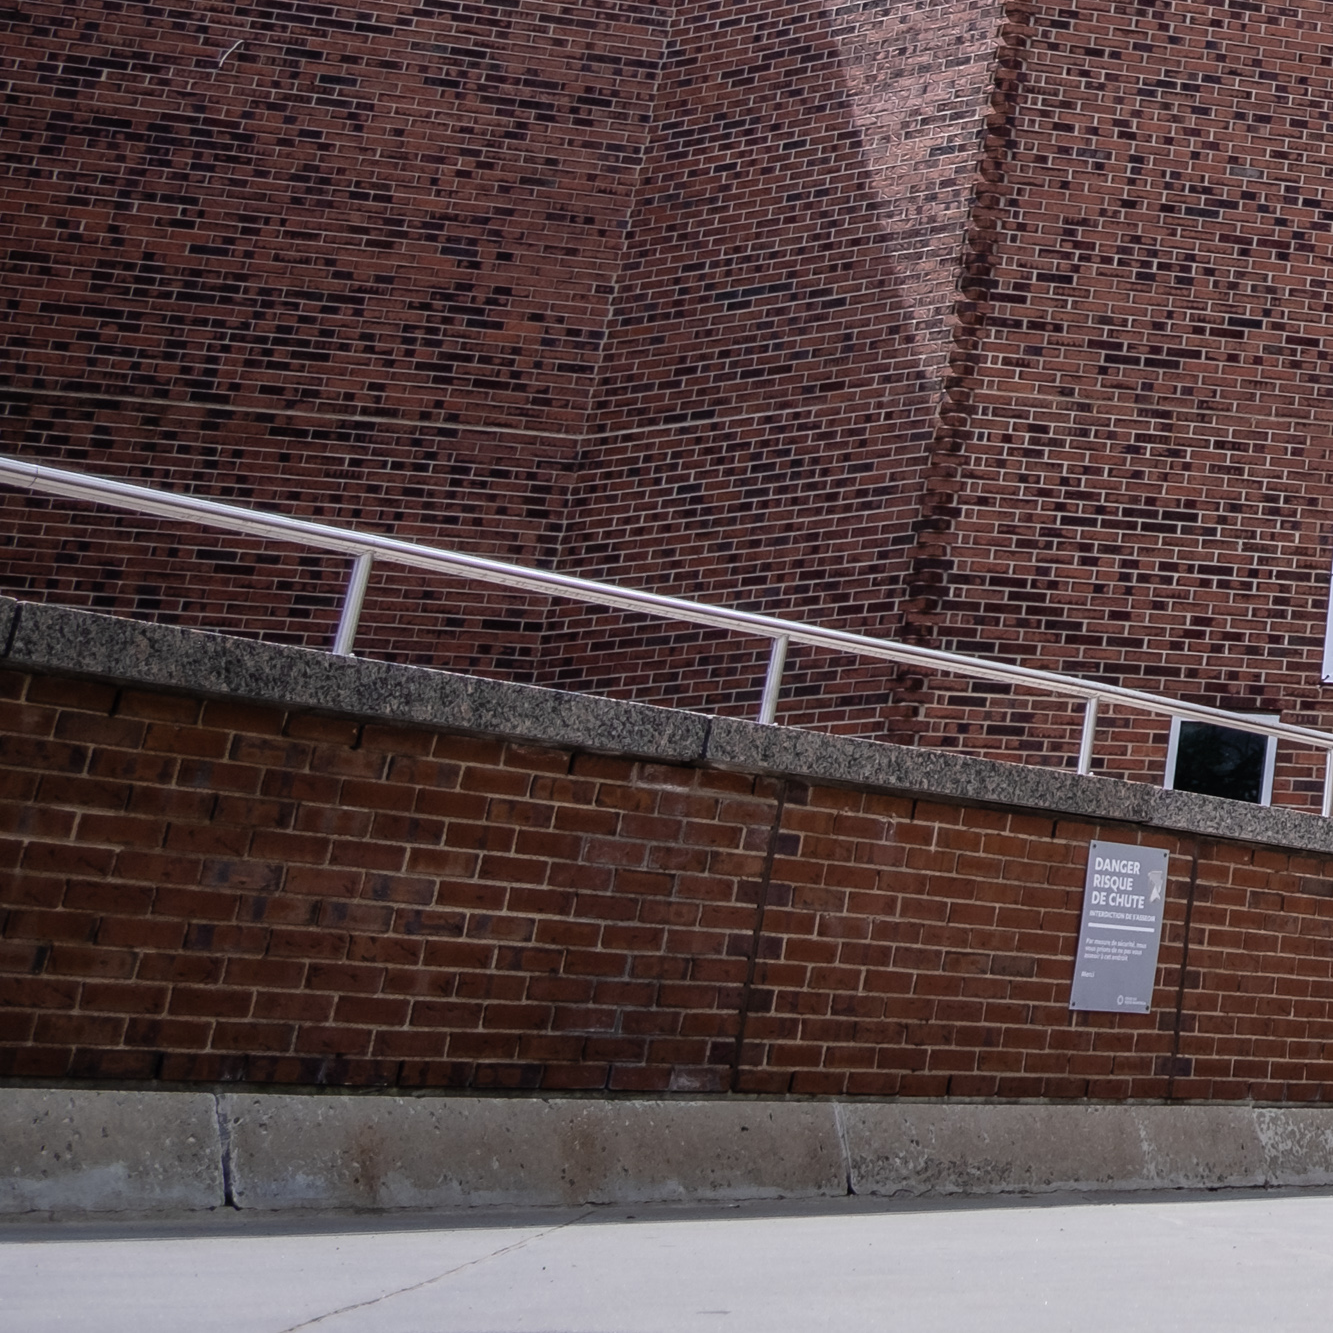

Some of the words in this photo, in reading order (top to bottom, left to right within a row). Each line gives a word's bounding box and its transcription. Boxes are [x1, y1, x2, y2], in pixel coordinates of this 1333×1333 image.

[1095, 857, 1141, 875] DANGER
[1093, 873, 1134, 892] RISQUE
[1091, 890, 1107, 905] DE
[1108, 892, 1145, 909] CHUTE
[1089, 910, 1125, 919] INTERDICTION
